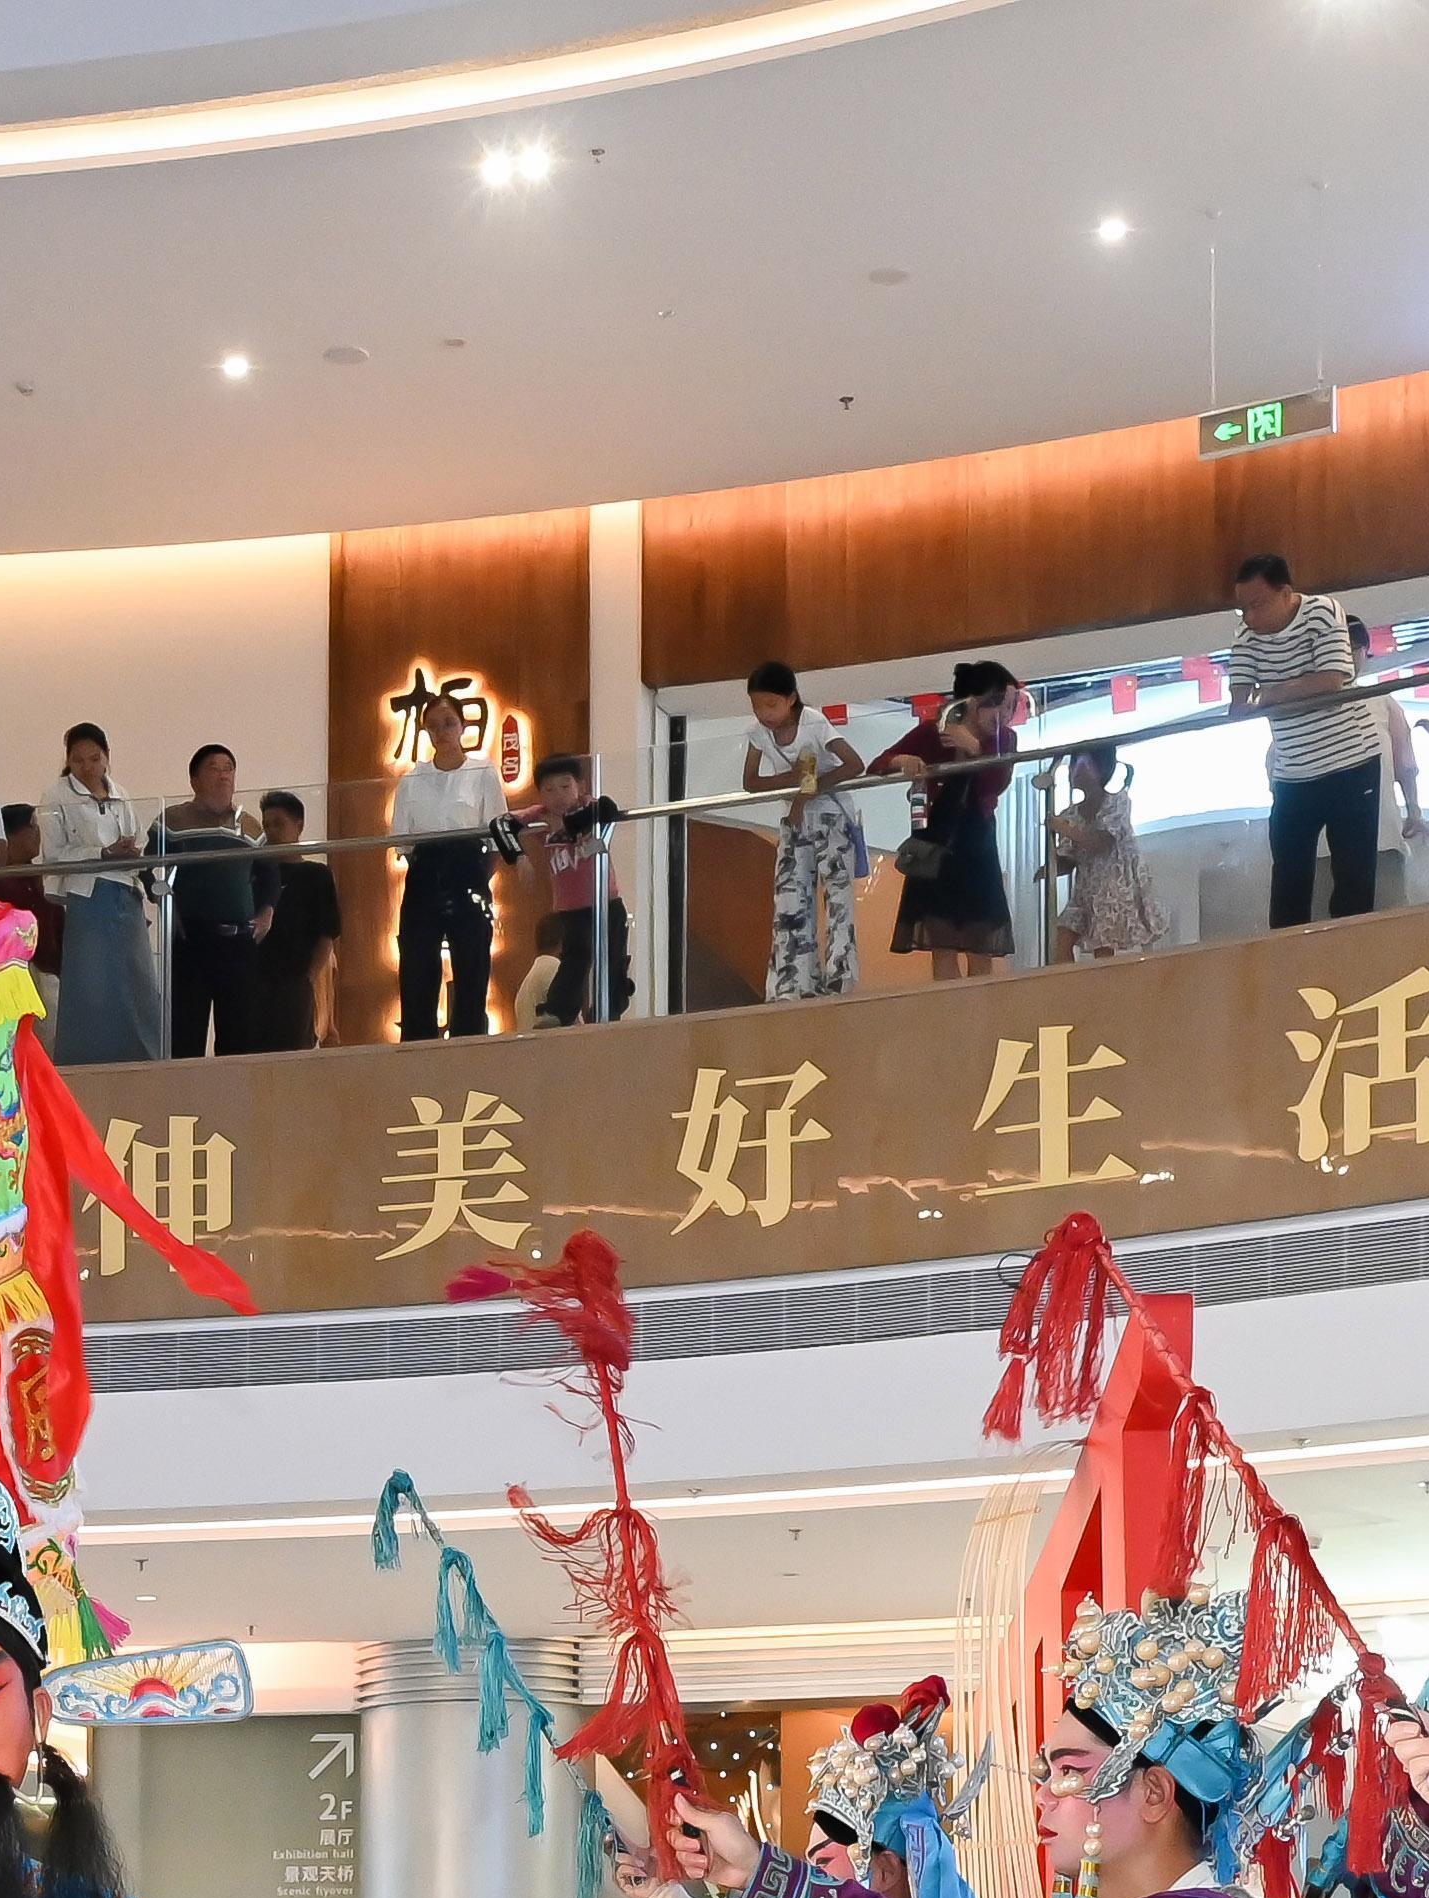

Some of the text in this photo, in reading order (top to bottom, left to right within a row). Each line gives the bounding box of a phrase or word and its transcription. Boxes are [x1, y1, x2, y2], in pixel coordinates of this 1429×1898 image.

[319, 1793, 353, 1821] 2F
[320, 1829, 354, 1846] 展厅
[332, 1850, 354, 1859] hall
[285, 1865, 354, 1883] 景观天桥
[277, 1886, 311, 1896] Scenic
